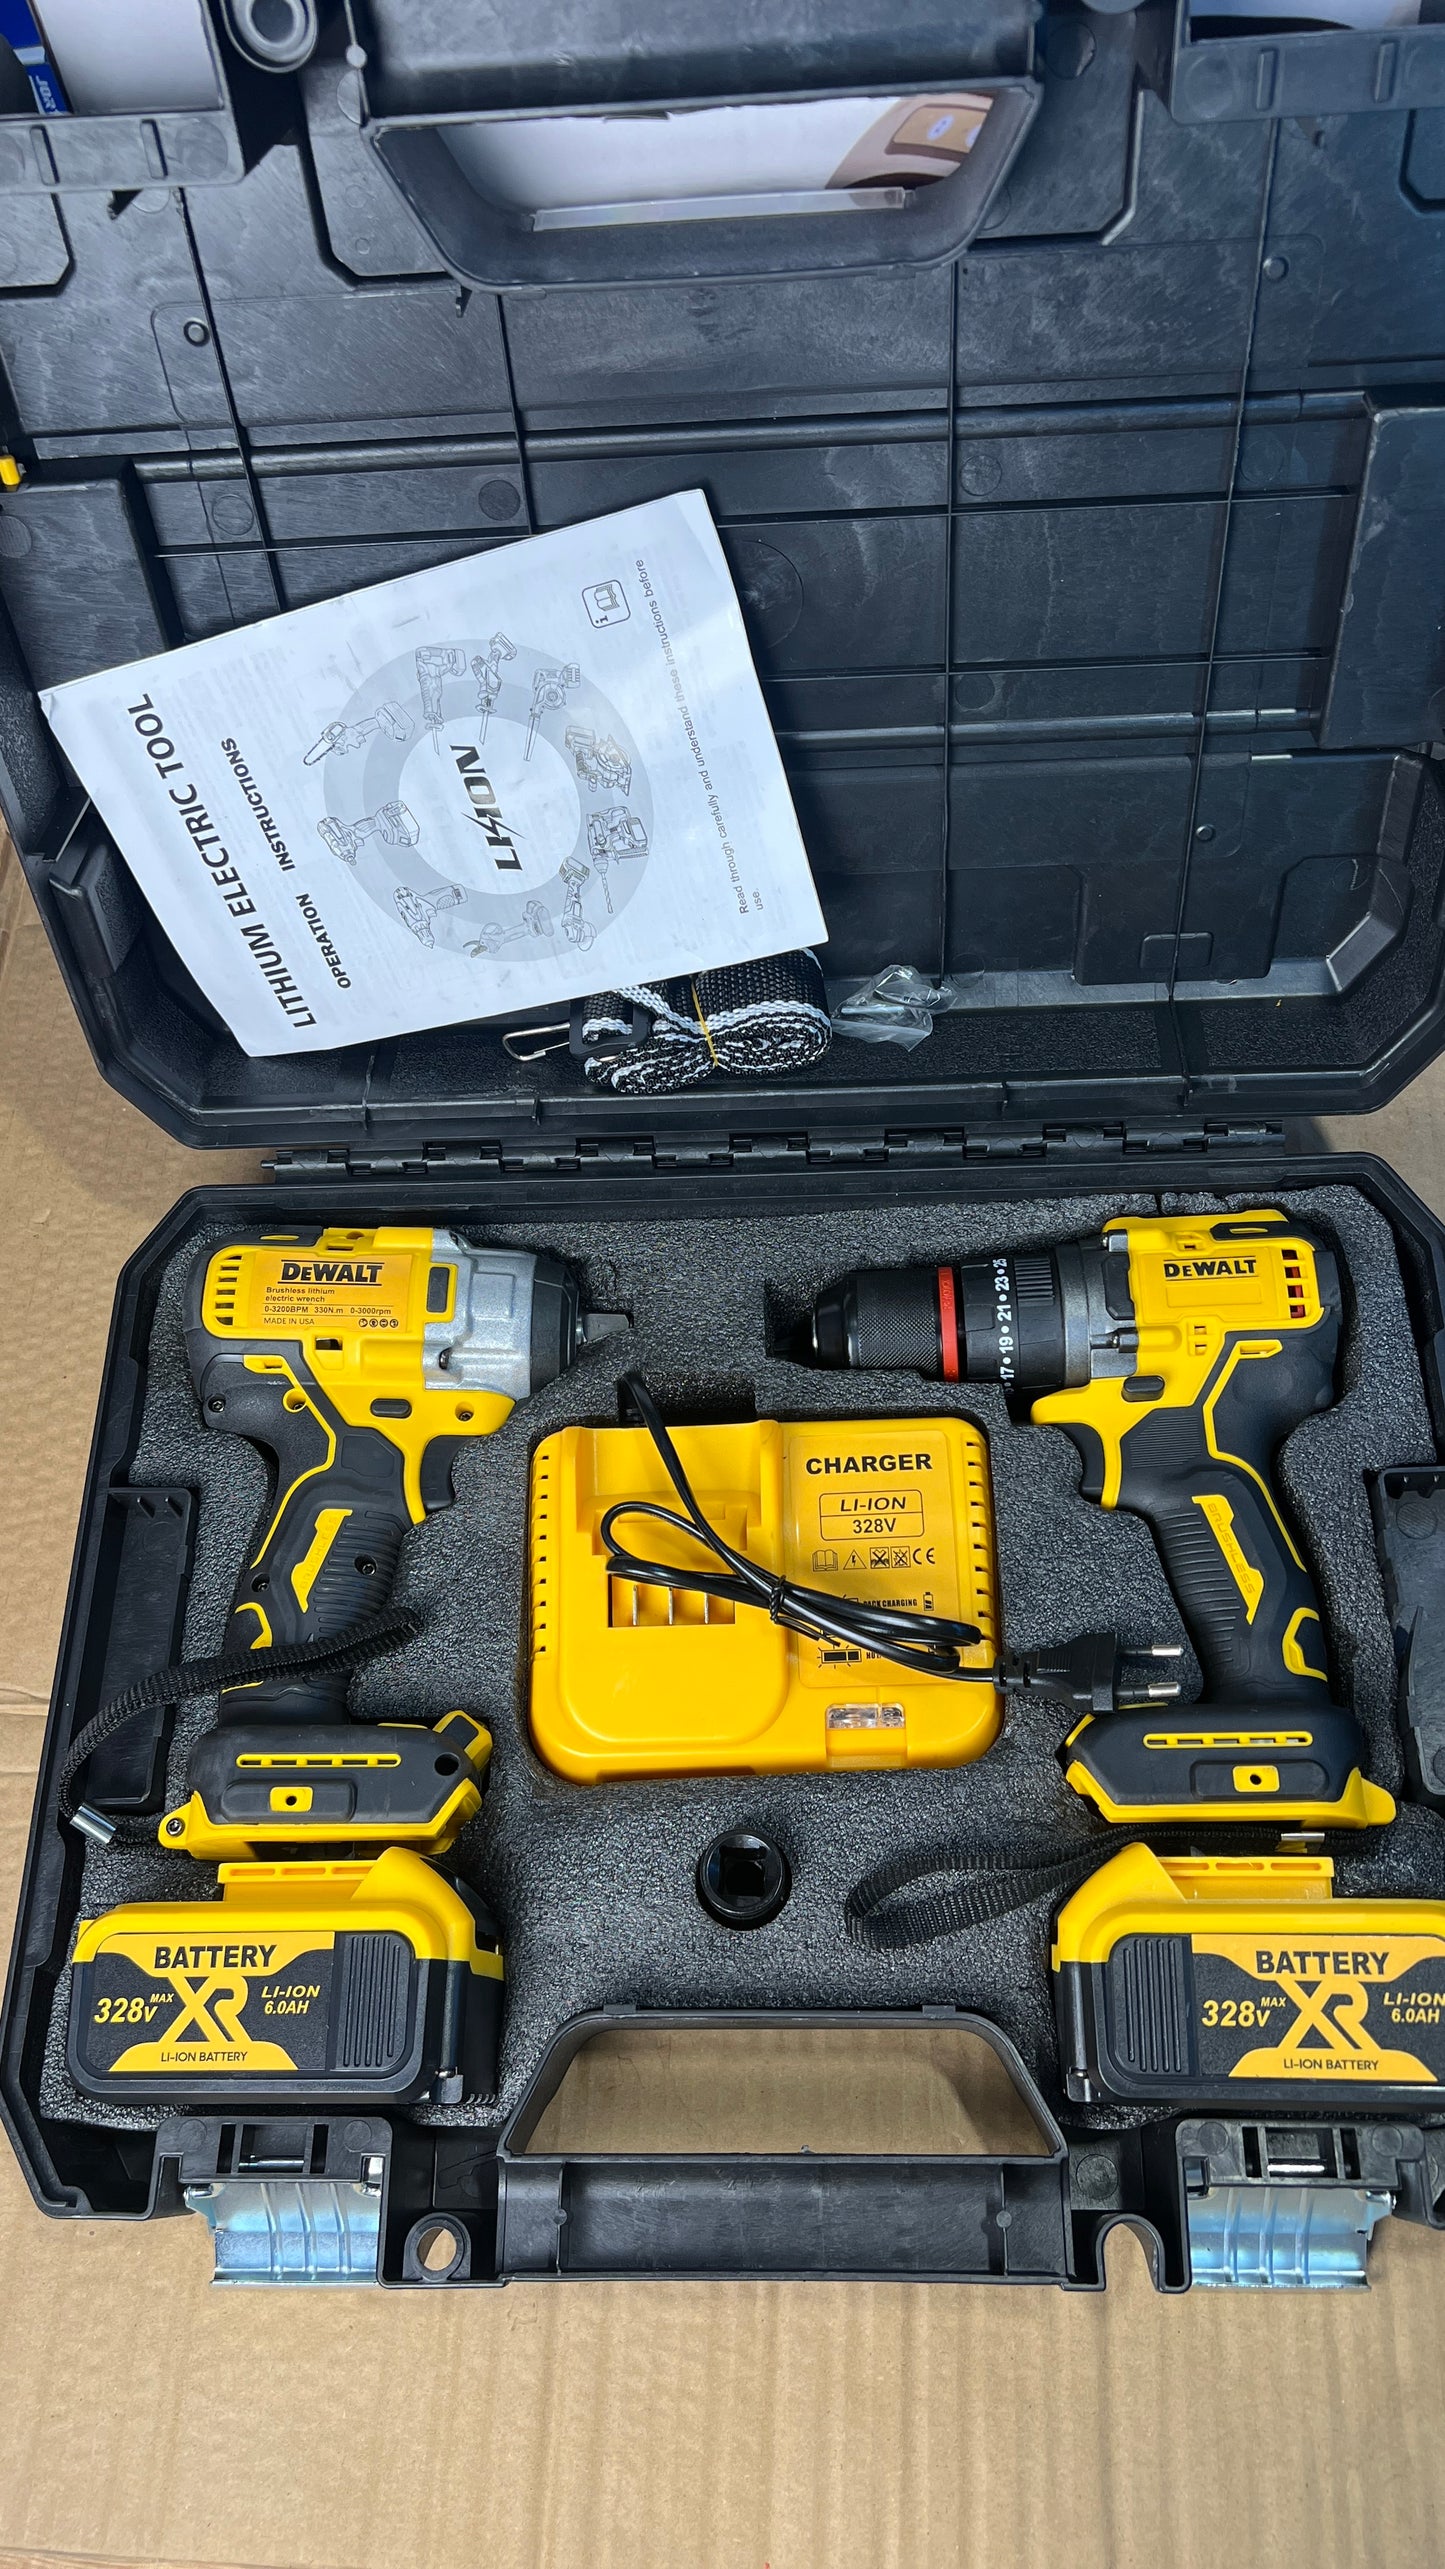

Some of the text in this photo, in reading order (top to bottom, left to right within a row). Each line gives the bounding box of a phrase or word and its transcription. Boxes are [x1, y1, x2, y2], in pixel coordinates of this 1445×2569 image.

[635, 559, 749, 914] Read through carefully and understand these instructions before
[127, 693, 317, 1028] LITHIUM ELECTRIC TOOL
[221, 737, 352, 989] OPERATION INSTRUCTIONS
[994, 1275, 1010, 1291] 23
[266, 1287, 335, 1295] Brushless lithium
[265, 1295, 325, 1303] electric wrench
[264, 1305, 309, 1314] 0-3200BPM
[350, 1307, 392, 1316] 0-3000rpm
[996, 1304, 1012, 1322] 21
[263, 1317, 315, 1326] MADE IN USA
[998, 1336, 1014, 1354] 19
[1000, 1366, 1015, 1380] 17
[805, 1453, 933, 1475] CHARGER
[840, 1496, 907, 1512] LI-ION
[852, 1518, 897, 1534] 328V
[1207, 1503, 1255, 1593] BRUSHLESS
[882, 1598, 918, 1608] CHARGING
[154, 1945, 277, 1969] BATTERY
[1255, 1950, 1390, 1975] BATTERY
[150, 1993, 175, 2003] MAX
[261, 1985, 321, 1999] LI-ION
[1383, 1992, 1445, 2007] LI-ION
[264, 2000, 310, 2015] 6.0AH
[1261, 1996, 1286, 2008] MAX
[1391, 2007, 1440, 2024] 6.0AH
[160, 2051, 248, 2063] LI-ION BATTERY
[1283, 2058, 1380, 2071] LI-ION BATTERY
